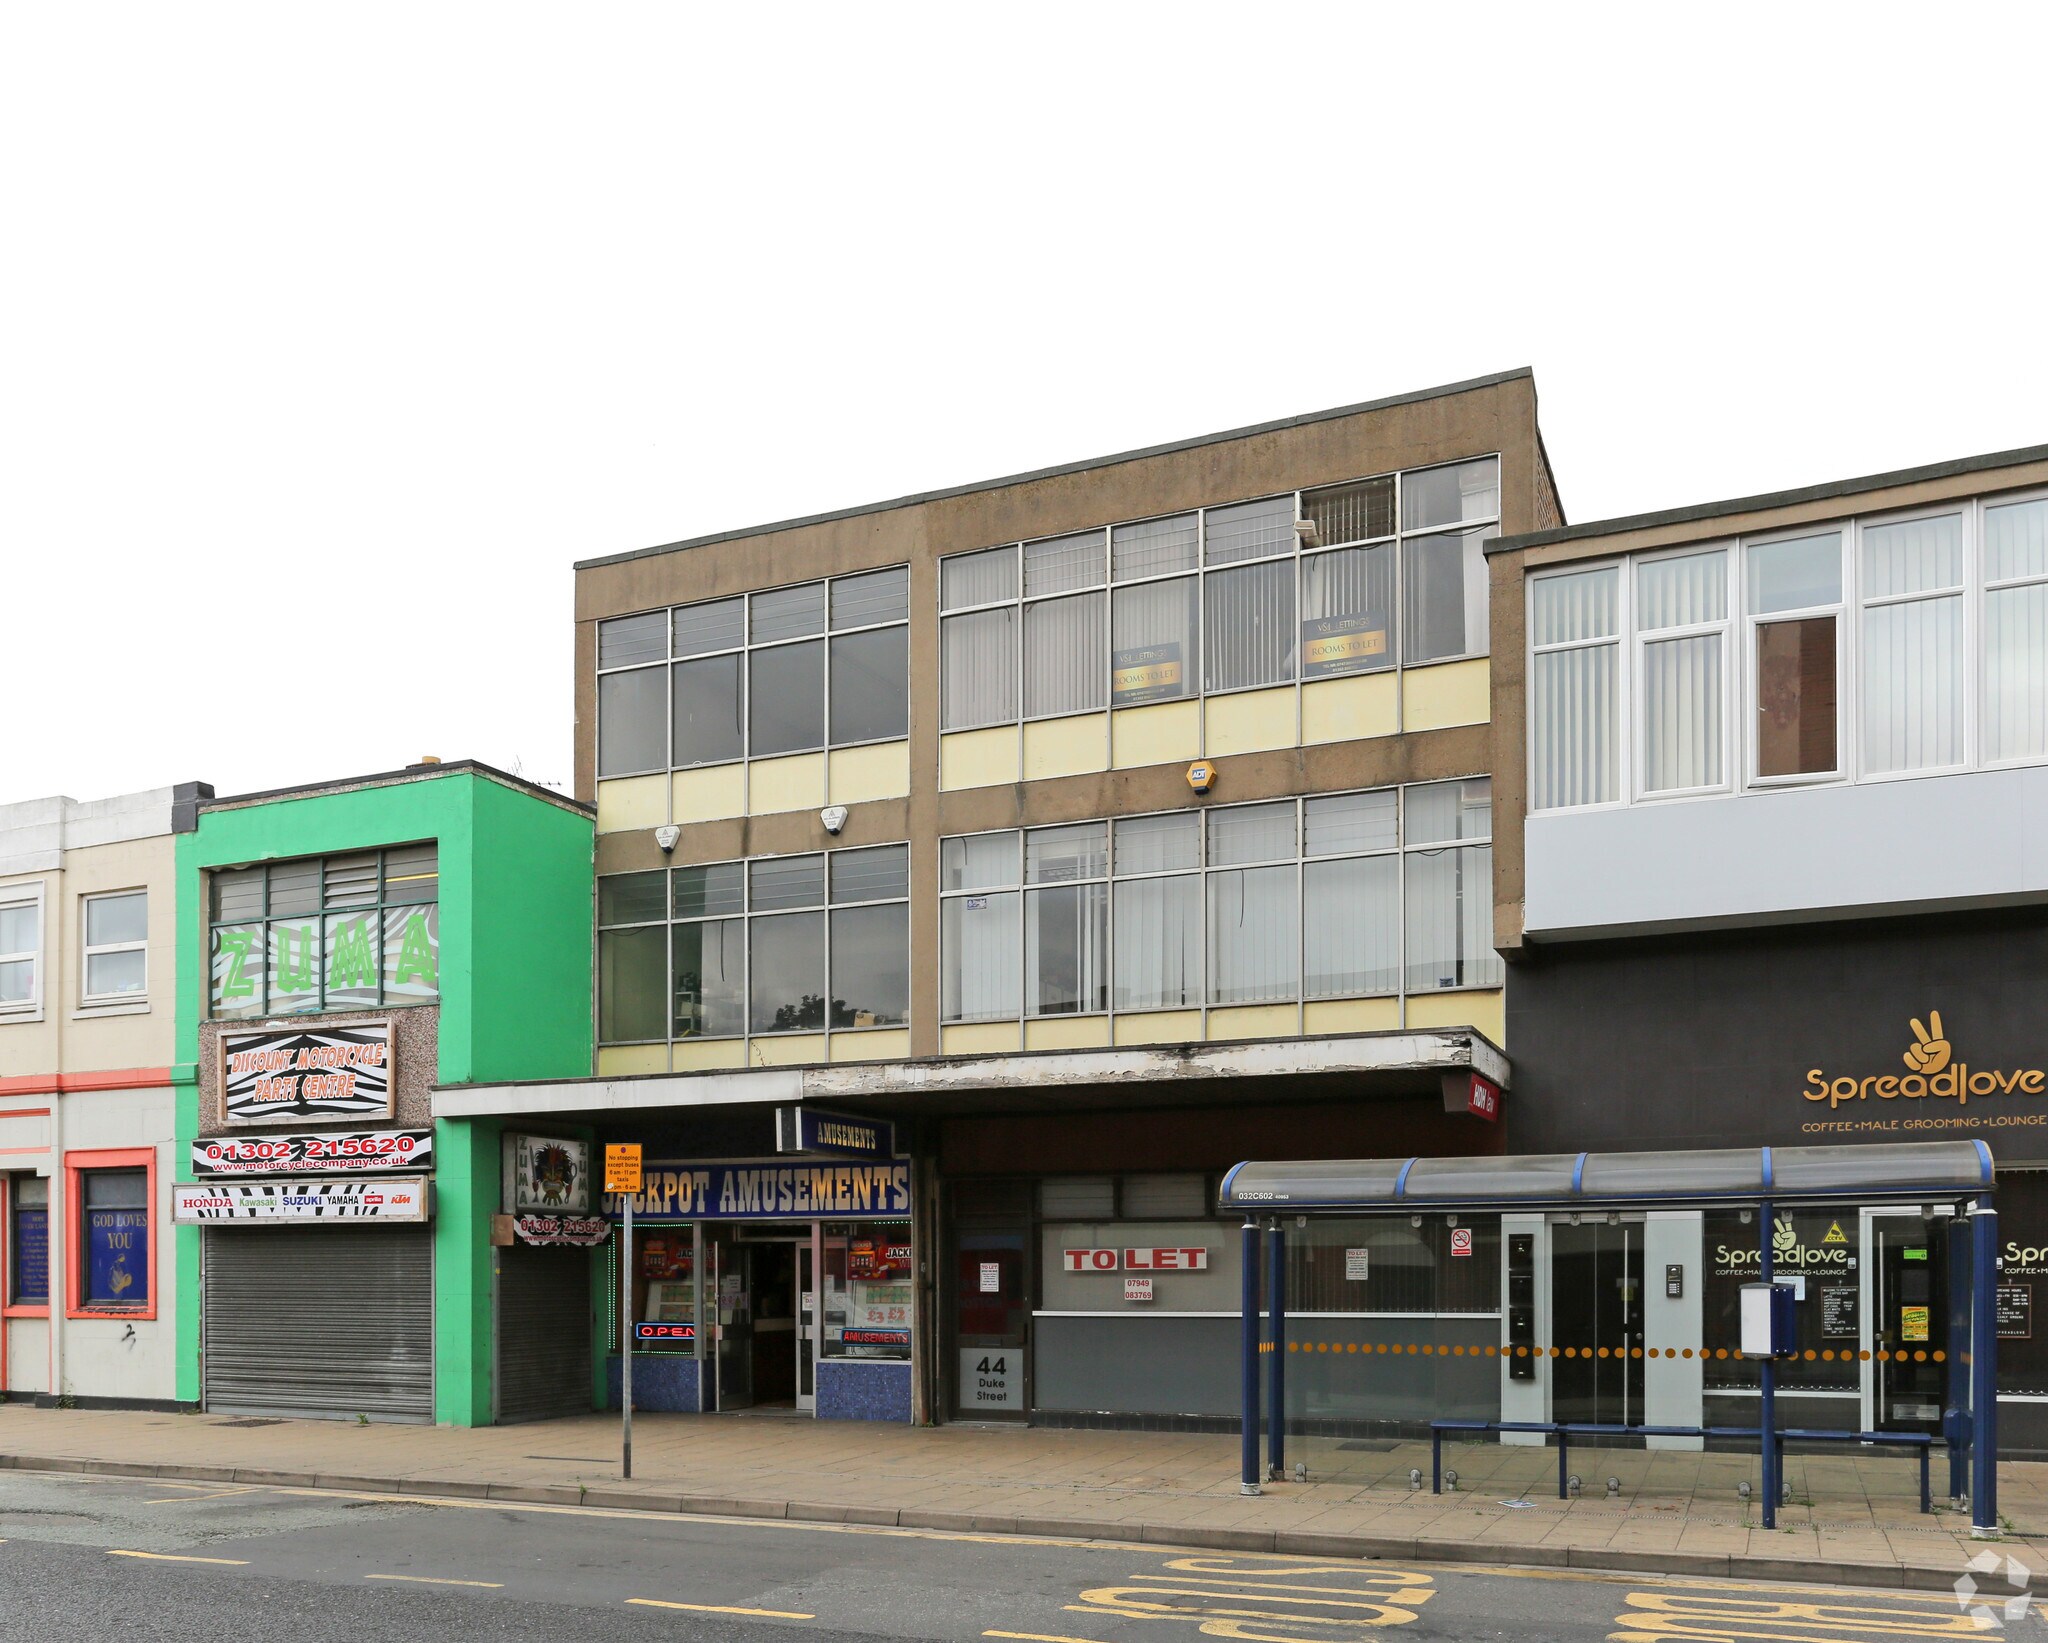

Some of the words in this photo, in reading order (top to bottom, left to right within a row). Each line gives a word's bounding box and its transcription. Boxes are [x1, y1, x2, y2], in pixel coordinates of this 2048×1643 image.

[1312, 644, 1345, 656] ROOMS
[1346, 641, 1360, 651] TO
[1363, 639, 1378, 649] LET
[1114, 674, 1144, 685] ROOMS
[1146, 672, 1158, 681] TO
[1160, 669, 1174, 679] LET
[221, 914, 436, 997] ZUMA
[231, 1051, 293, 1073] DISCOUNT
[297, 1043, 385, 1070] MOTORCYCLE
[254, 1077, 297, 1101] PARTS
[302, 1074, 356, 1099] CENTRE
[1803, 1063, 2046, 1108] Spreadlove
[1802, 1122, 1852, 1132] COFFEE
[1861, 1120, 1899, 1130] MALE
[1903, 1117, 1980, 1129] GROOMING
[1989, 1115, 2047, 1127] LOUNGE
[817, 1121, 876, 1150] AMUSEMENTS
[207, 1143, 291, 1160] 01302
[306, 1137, 416, 1156] 215620
[213, 1156, 408, 1171] www.motorcyclecompany.co.uk
[518, 1136, 528, 1205] ZUMA
[719, 1166, 909, 1213] AMUSEMENTS
[1238, 1192, 1273, 1200] 032C602
[183, 1198, 233, 1208] HONDA
[239, 1197, 277, 1206] Kawasaki
[283, 1196, 322, 1206] SUZUKI
[327, 1195, 359, 1205] YAMAHA
[391, 1194, 411, 1204] KTM
[93, 1214, 114, 1227] GOD
[116, 1213, 147, 1228] LOVES
[520, 1219, 558, 1232] 01302
[564, 1220, 606, 1233] 215620
[107, 1232, 133, 1249] YOU
[1066, 1250, 1116, 1270] TO
[1126, 1248, 1206, 1268] LET
[1127, 1280, 1150, 1288] 07949
[1125, 1291, 1152, 1299] 083769
[641, 1327, 694, 1336] OPEN
[844, 1330, 908, 1343] AMUSEMENTS
[976, 1357, 1007, 1375] 44
[978, 1378, 1005, 1388] Duke
[977, 1391, 1008, 1401] Street
